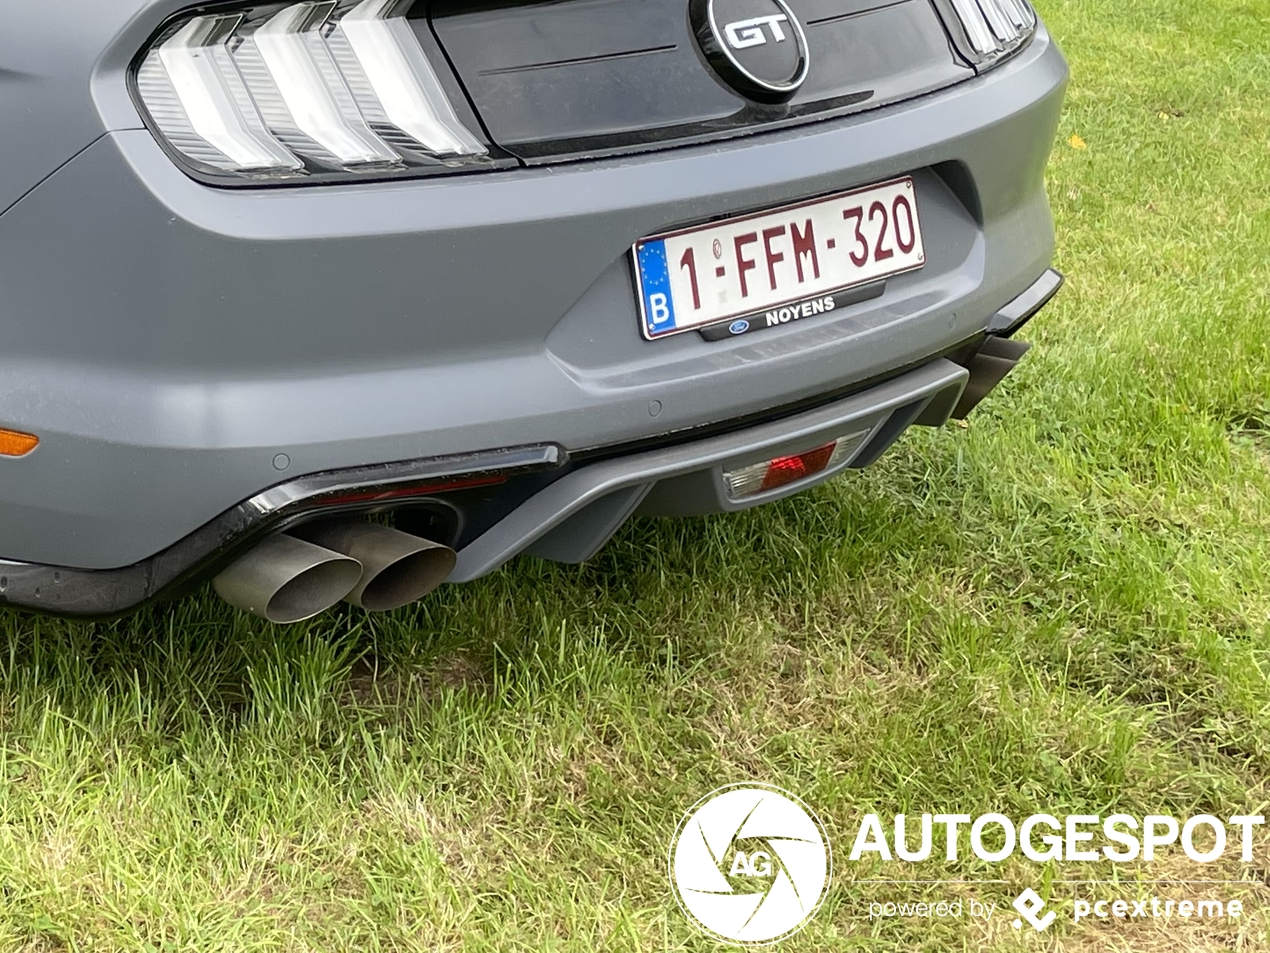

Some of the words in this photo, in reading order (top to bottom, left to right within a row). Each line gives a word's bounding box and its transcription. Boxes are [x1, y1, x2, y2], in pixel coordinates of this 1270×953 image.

[724, 13, 788, 49] GT
[650, 293, 669, 324] B
[765, 296, 835, 326] NOYENS
